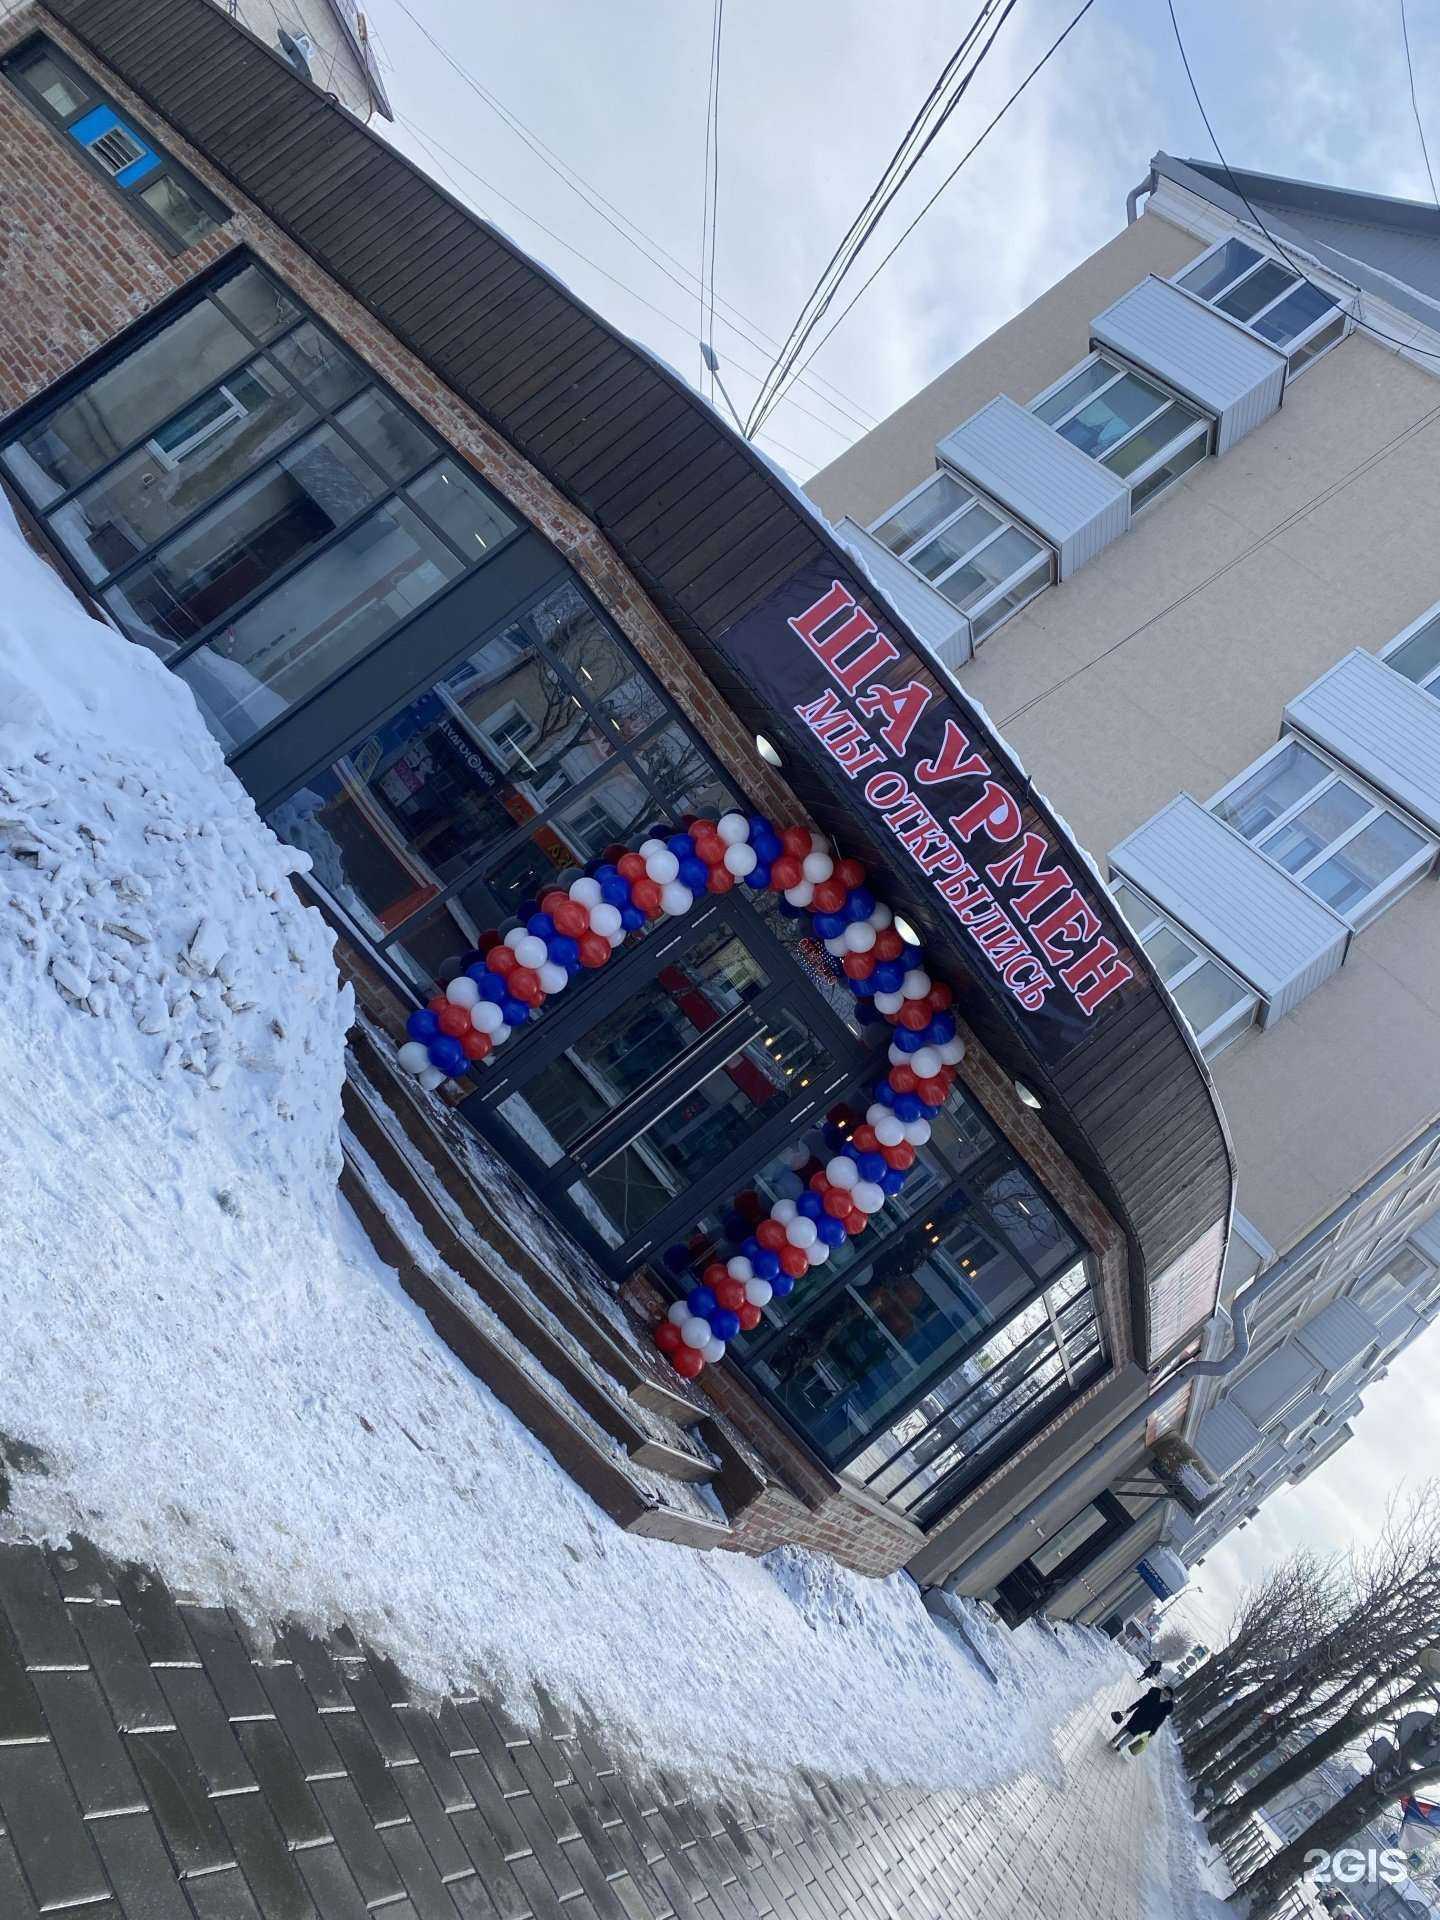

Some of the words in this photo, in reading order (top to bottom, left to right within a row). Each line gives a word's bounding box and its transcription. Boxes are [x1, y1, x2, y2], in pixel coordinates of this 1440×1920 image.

[788, 581, 1133, 1016] ШАУРМЕН
[795, 689, 886, 778] МЫ
[865, 772, 1056, 1010] ОТКРЫЛИСЬ
